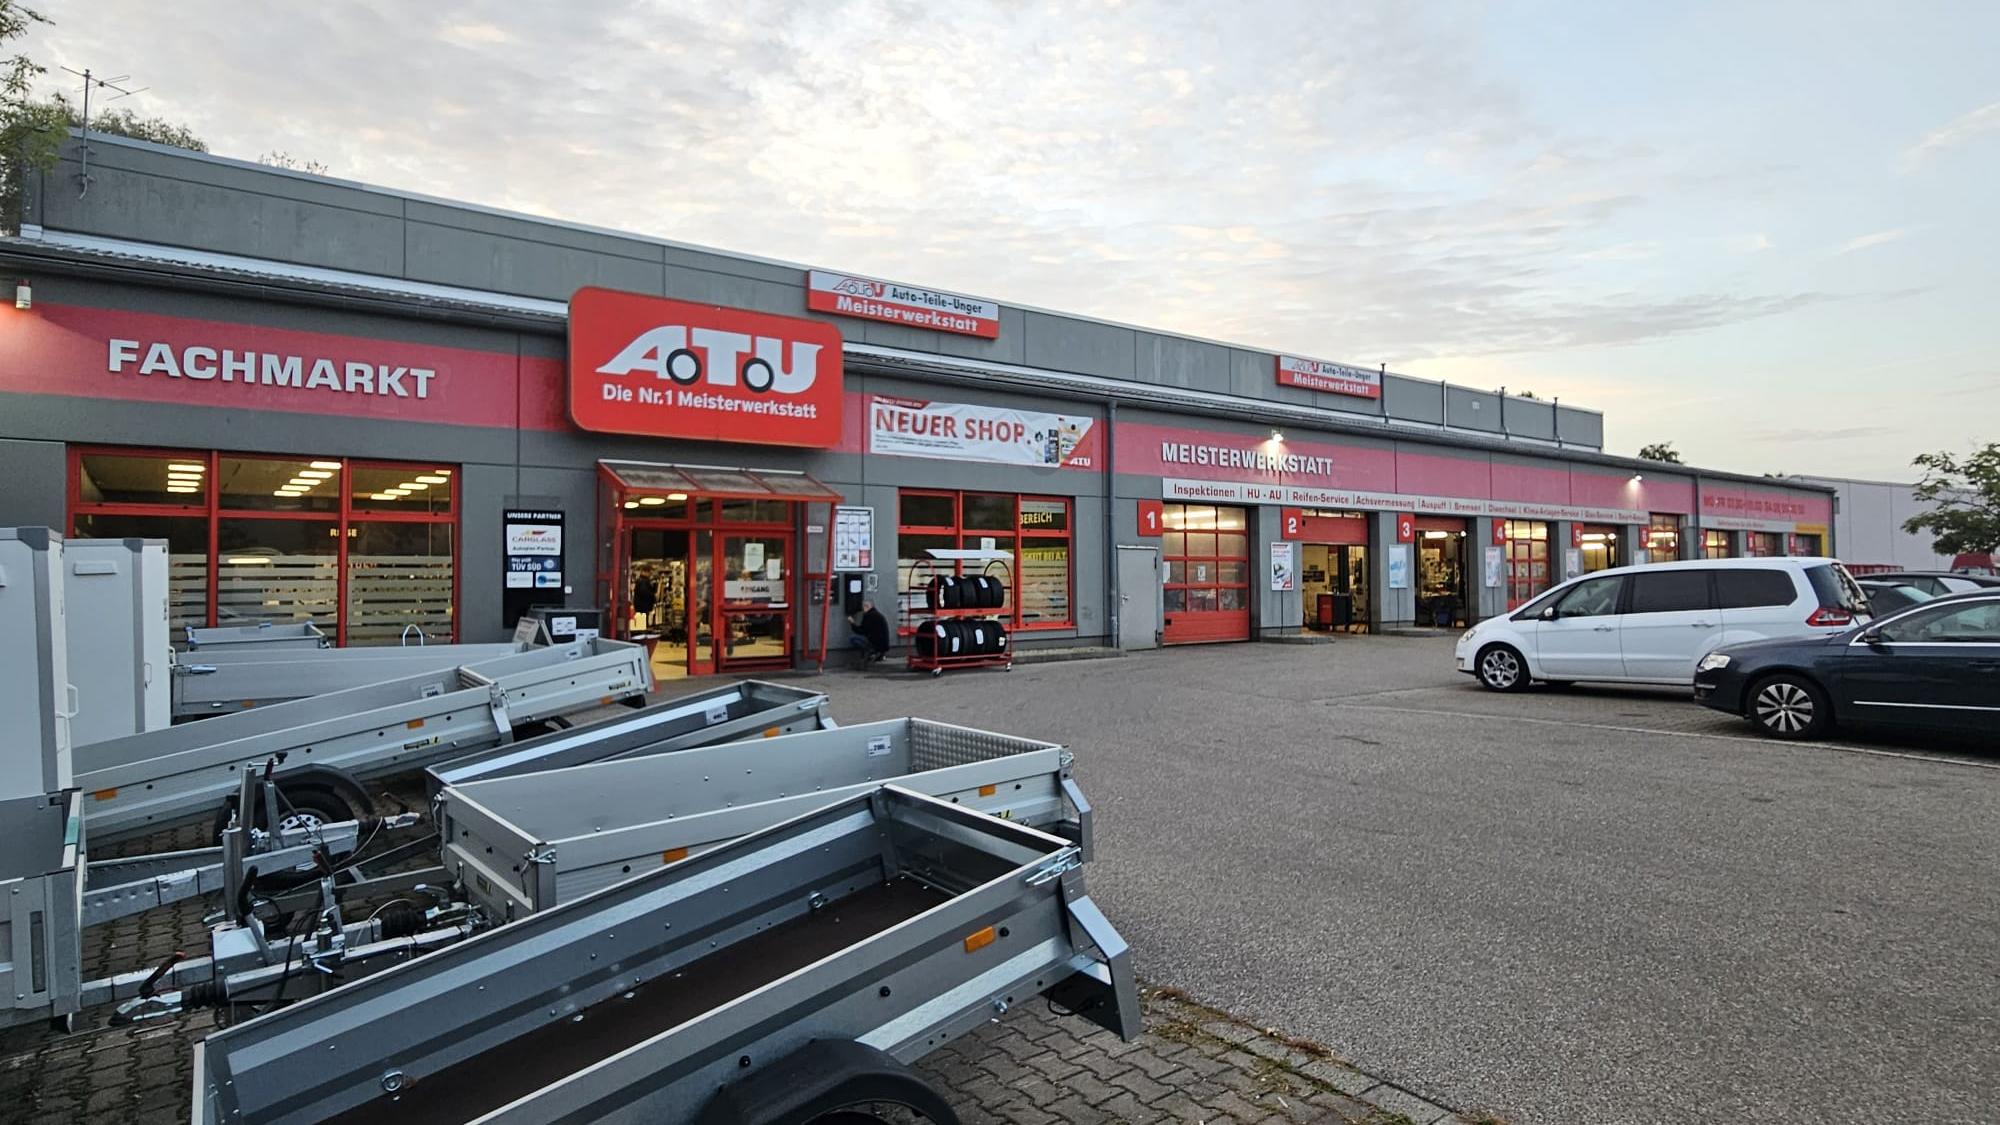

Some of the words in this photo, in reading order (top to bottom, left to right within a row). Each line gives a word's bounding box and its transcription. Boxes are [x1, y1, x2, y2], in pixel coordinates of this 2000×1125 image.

[892, 288, 982, 315] Auto-Teile-Unger
[836, 296, 978, 332] Meisterwerkstatt
[108, 338, 436, 399] FACHMARKT
[1294, 373, 1369, 394] Meisterwerkstatt
[603, 383, 632, 402] Die
[639, 386, 673, 405] Nr.1
[677, 391, 817, 419] Meisterwerkstatt
[875, 408, 958, 438] NEUER
[964, 418, 1032, 445] SHOP.
[1069, 456, 1091, 467] ATU
[1162, 442, 1334, 475] MEISTERWERKSTATT
[1174, 484, 1235, 498] Inspektionen
[1247, 490, 1260, 499] HU
[1269, 490, 1282, 500] AU
[1292, 491, 1349, 504] Reifen-Service
[1356, 495, 1415, 510] Achsvermessung
[1421, 499, 1446, 510] Auspuff
[1147, 511, 1156, 529] 1
[1288, 517, 1297, 534] 2
[1402, 521, 1411, 538] 3
[1496, 526, 1504, 540] 4
[1575, 529, 1582, 543] 5
[511, 562, 526, 570] TÜV
[527, 563, 542, 571] SÜD
